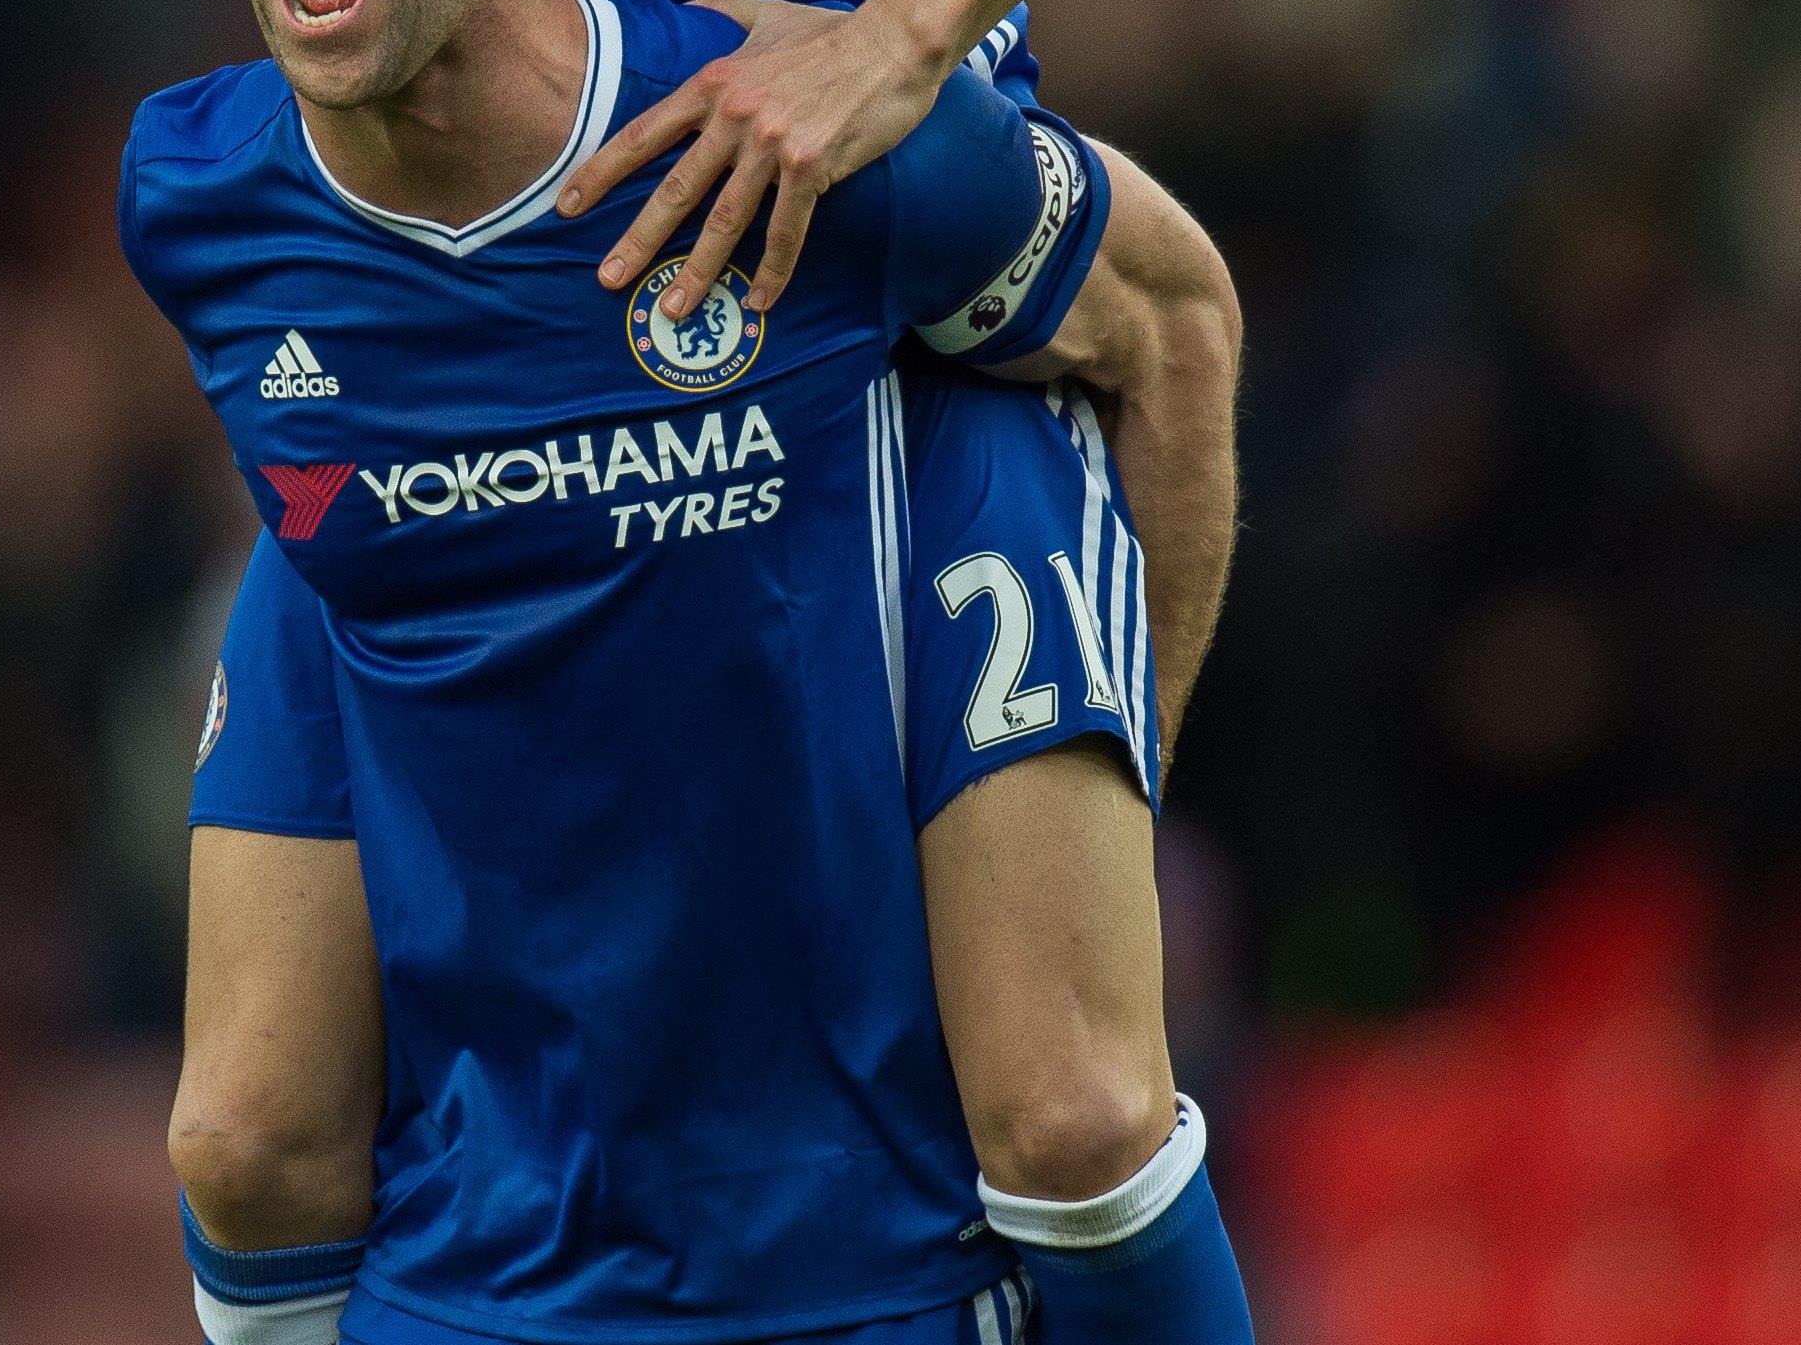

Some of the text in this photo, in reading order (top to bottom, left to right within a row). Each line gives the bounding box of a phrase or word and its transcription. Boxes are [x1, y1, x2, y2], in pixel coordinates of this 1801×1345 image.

[647, 262, 732, 294] CHEA
[260, 371, 340, 399] adidas
[656, 353, 746, 385] FOOTBALL CLUB
[358, 404, 786, 525] YOKOHAMA
[608, 477, 786, 549] TYRES
[933, 550, 1122, 752] 21
